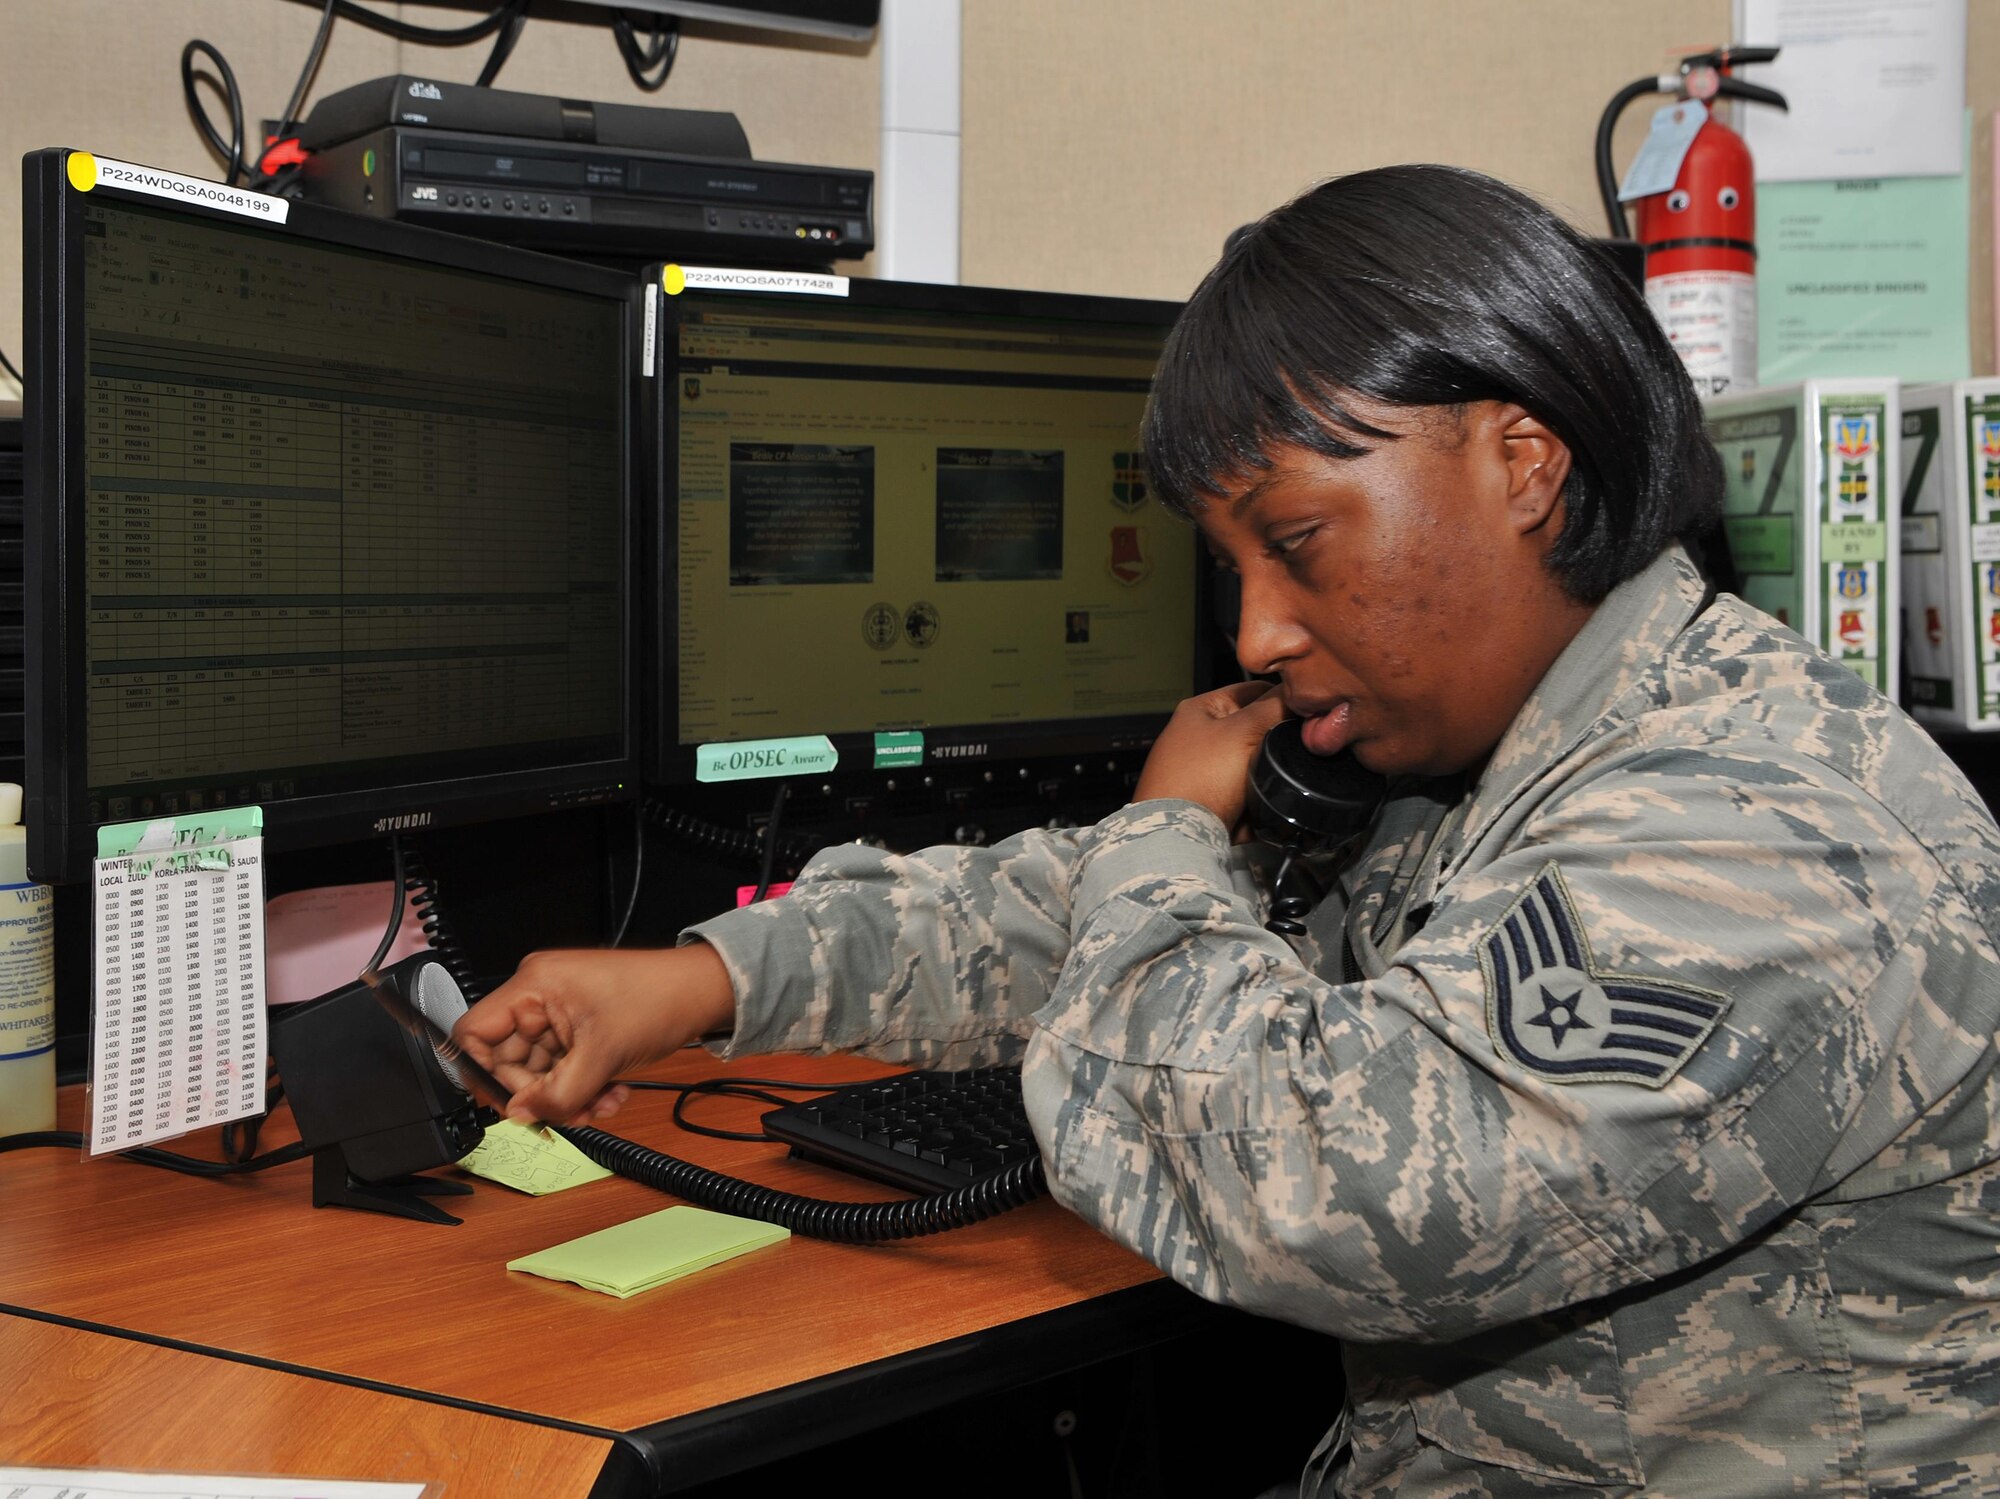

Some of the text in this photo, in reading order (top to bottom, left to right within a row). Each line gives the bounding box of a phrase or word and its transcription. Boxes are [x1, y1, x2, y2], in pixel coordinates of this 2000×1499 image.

[409, 82, 443, 100] dish
[102, 167, 270, 213] P224WDQSA0048199
[412, 186, 438, 200] JVC
[685, 271, 834, 290] P224WDQSA0717428
[713, 748, 825, 771] Be OPSEC Aware
[876, 745, 923, 755] UNCLASSIFIED
[934, 744, 988, 758] HYUNDAI
[377, 812, 432, 832] HYUNDAI
[100, 875, 124, 887] LOCAL
[128, 873, 147, 883] ZULU
[154, 868, 179, 879] KOREA
[237, 856, 259, 867] SAUDI
[101, 859, 134, 872] WINTER
[105, 872, 249, 900] 0000 0800 1700 1000 1100 1300
[105, 882, 249, 910] 0100 0900 1800 1100 1200 1400
[105, 892, 250, 921] 0200 1000 1900 1200 1300 1500
[105, 902, 250, 932] 0300 1100 2000 1300 1400 1600
[0, 916, 39, 928] PPROVED
[105, 912, 251, 943] 0400 1200 2100 1400 1500 1700
[106, 922, 251, 953] 0500 1300 2200 1500 1600 1800
[106, 932, 251, 964] 0600 1400 2300 1600 1700 1900
[106, 943, 251, 975] 0700 1500 0000 1700 1800 2000
[106, 953, 252, 986] 0800 1600 0100 1800 1900 2100
[106, 963, 252, 996] 0900 1700 0200 1900 2000 2200
[106, 973, 253, 1007] 1000 1800 0300 2000 2100 2300
[8, 997, 43, 1009] RE-ORDER
[106, 983, 253, 1018] 1100 1900 0400 2100 2200 0000
[106, 993, 254, 1028] 1200 2000 0500 2200 2300 0100
[105, 1003, 254, 1039] 1300 2100 0600 2300 0000 0200
[105, 1013, 255, 1049] 1400 2200 0700 0000 0100 0300
[105, 1022, 255, 1060] 1500 2300 0800 0100 0200 0400
